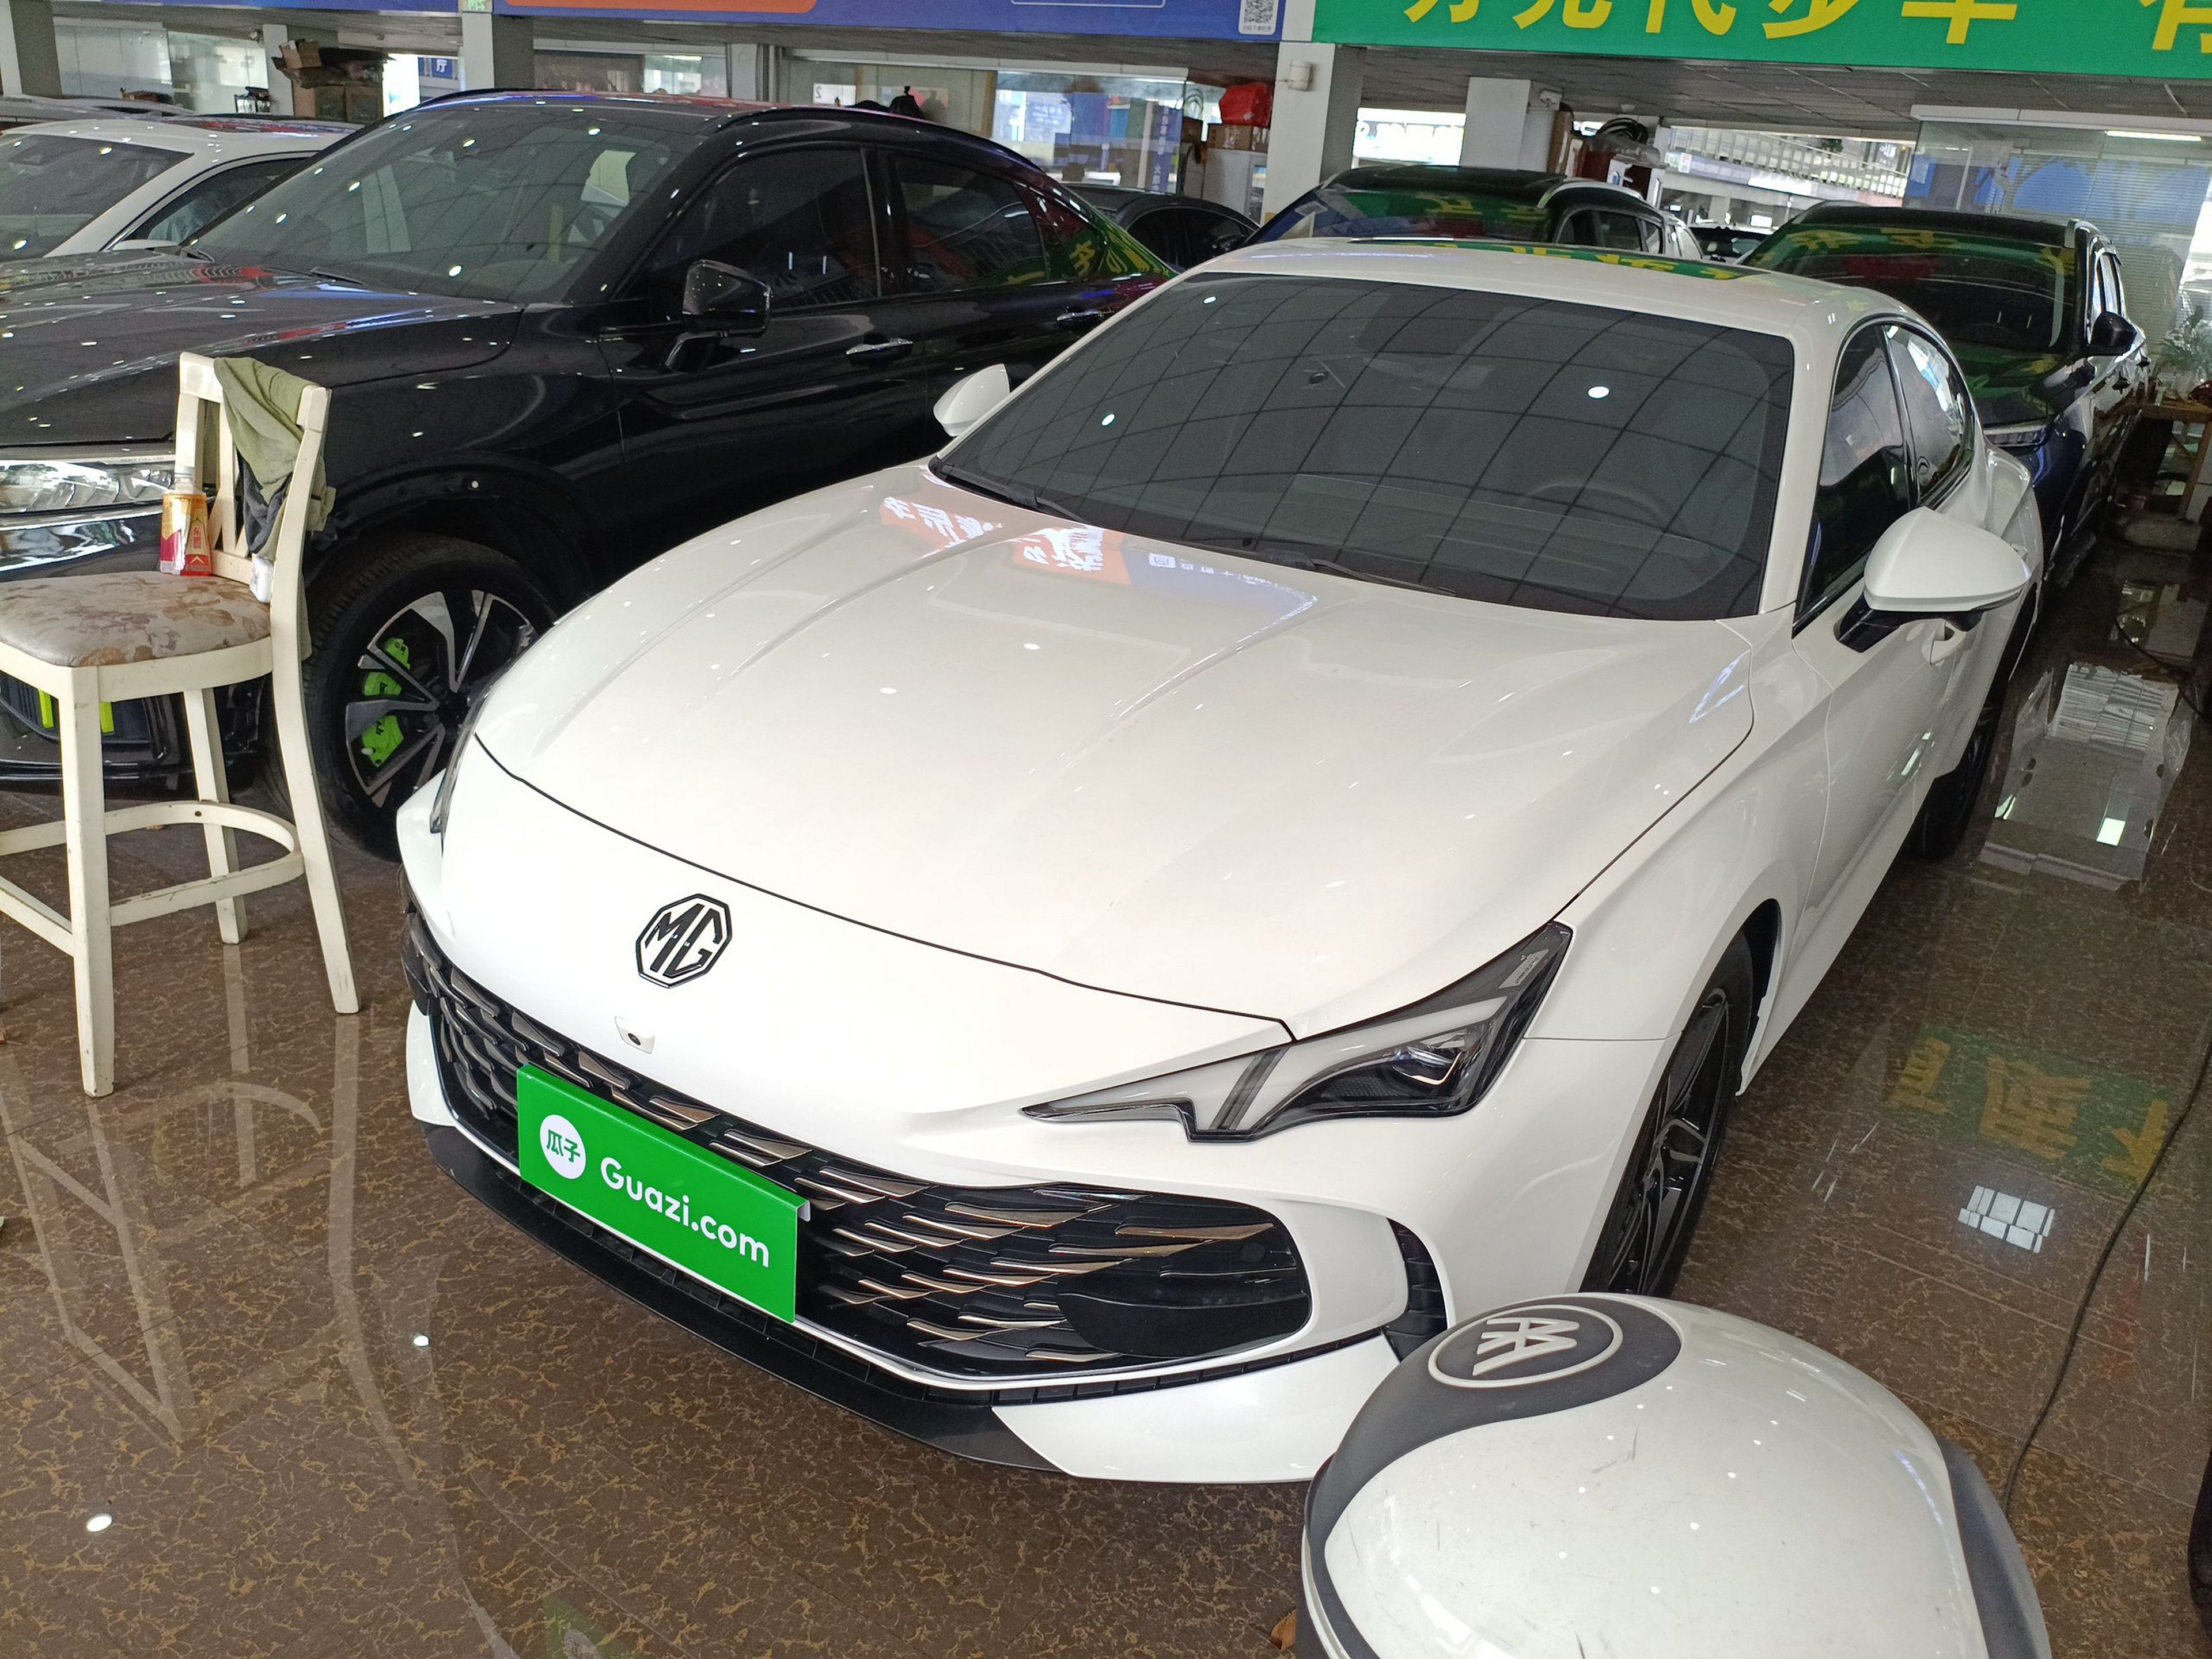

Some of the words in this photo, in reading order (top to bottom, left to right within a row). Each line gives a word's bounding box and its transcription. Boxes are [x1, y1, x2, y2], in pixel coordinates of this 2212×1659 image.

[644, 903, 724, 979] MG
[546, 1128, 581, 1163] 瓜子
[601, 1156, 769, 1268] Guazi.com
